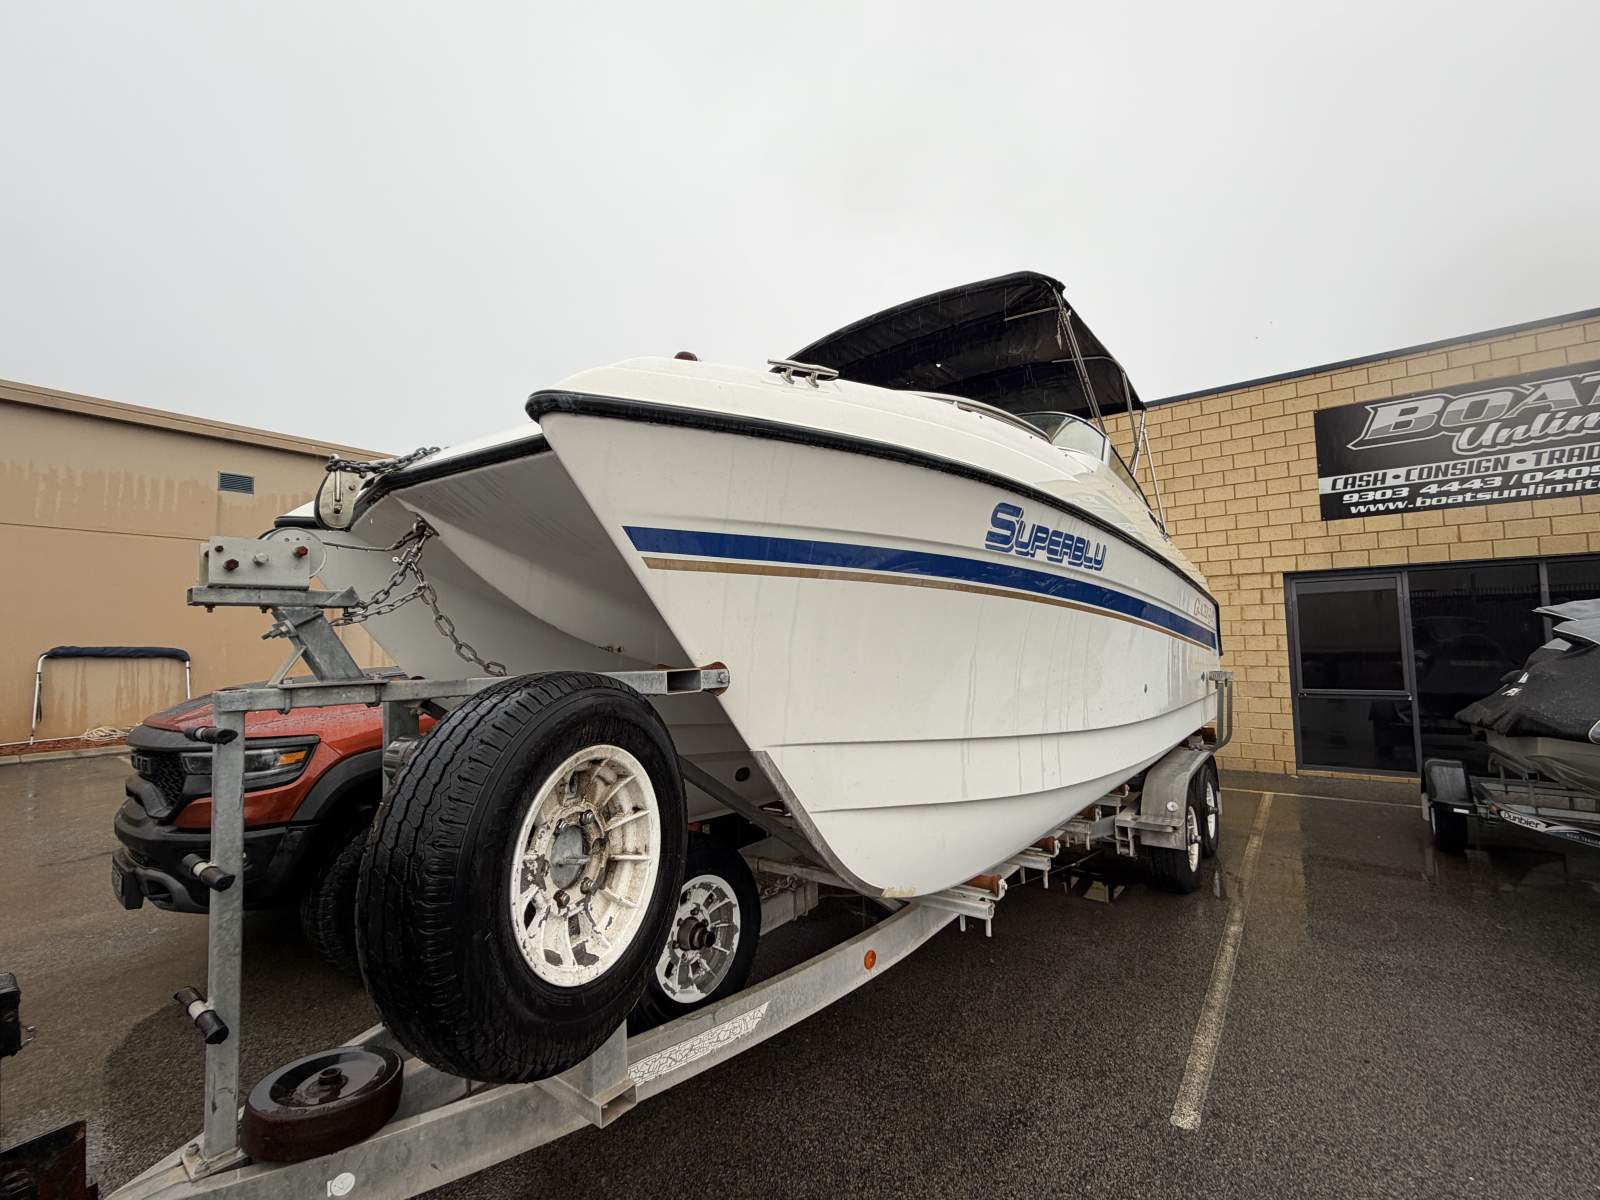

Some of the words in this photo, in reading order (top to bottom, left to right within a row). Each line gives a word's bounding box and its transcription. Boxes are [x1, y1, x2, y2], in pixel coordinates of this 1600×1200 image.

[1331, 472, 1387, 491] CASH
[1405, 456, 1510, 482] CONSIGN
[1342, 487, 1410, 504] 9303
[1420, 476, 1503, 494] 4443
[1350, 479, 1600, 514] www.boatsunlimit
